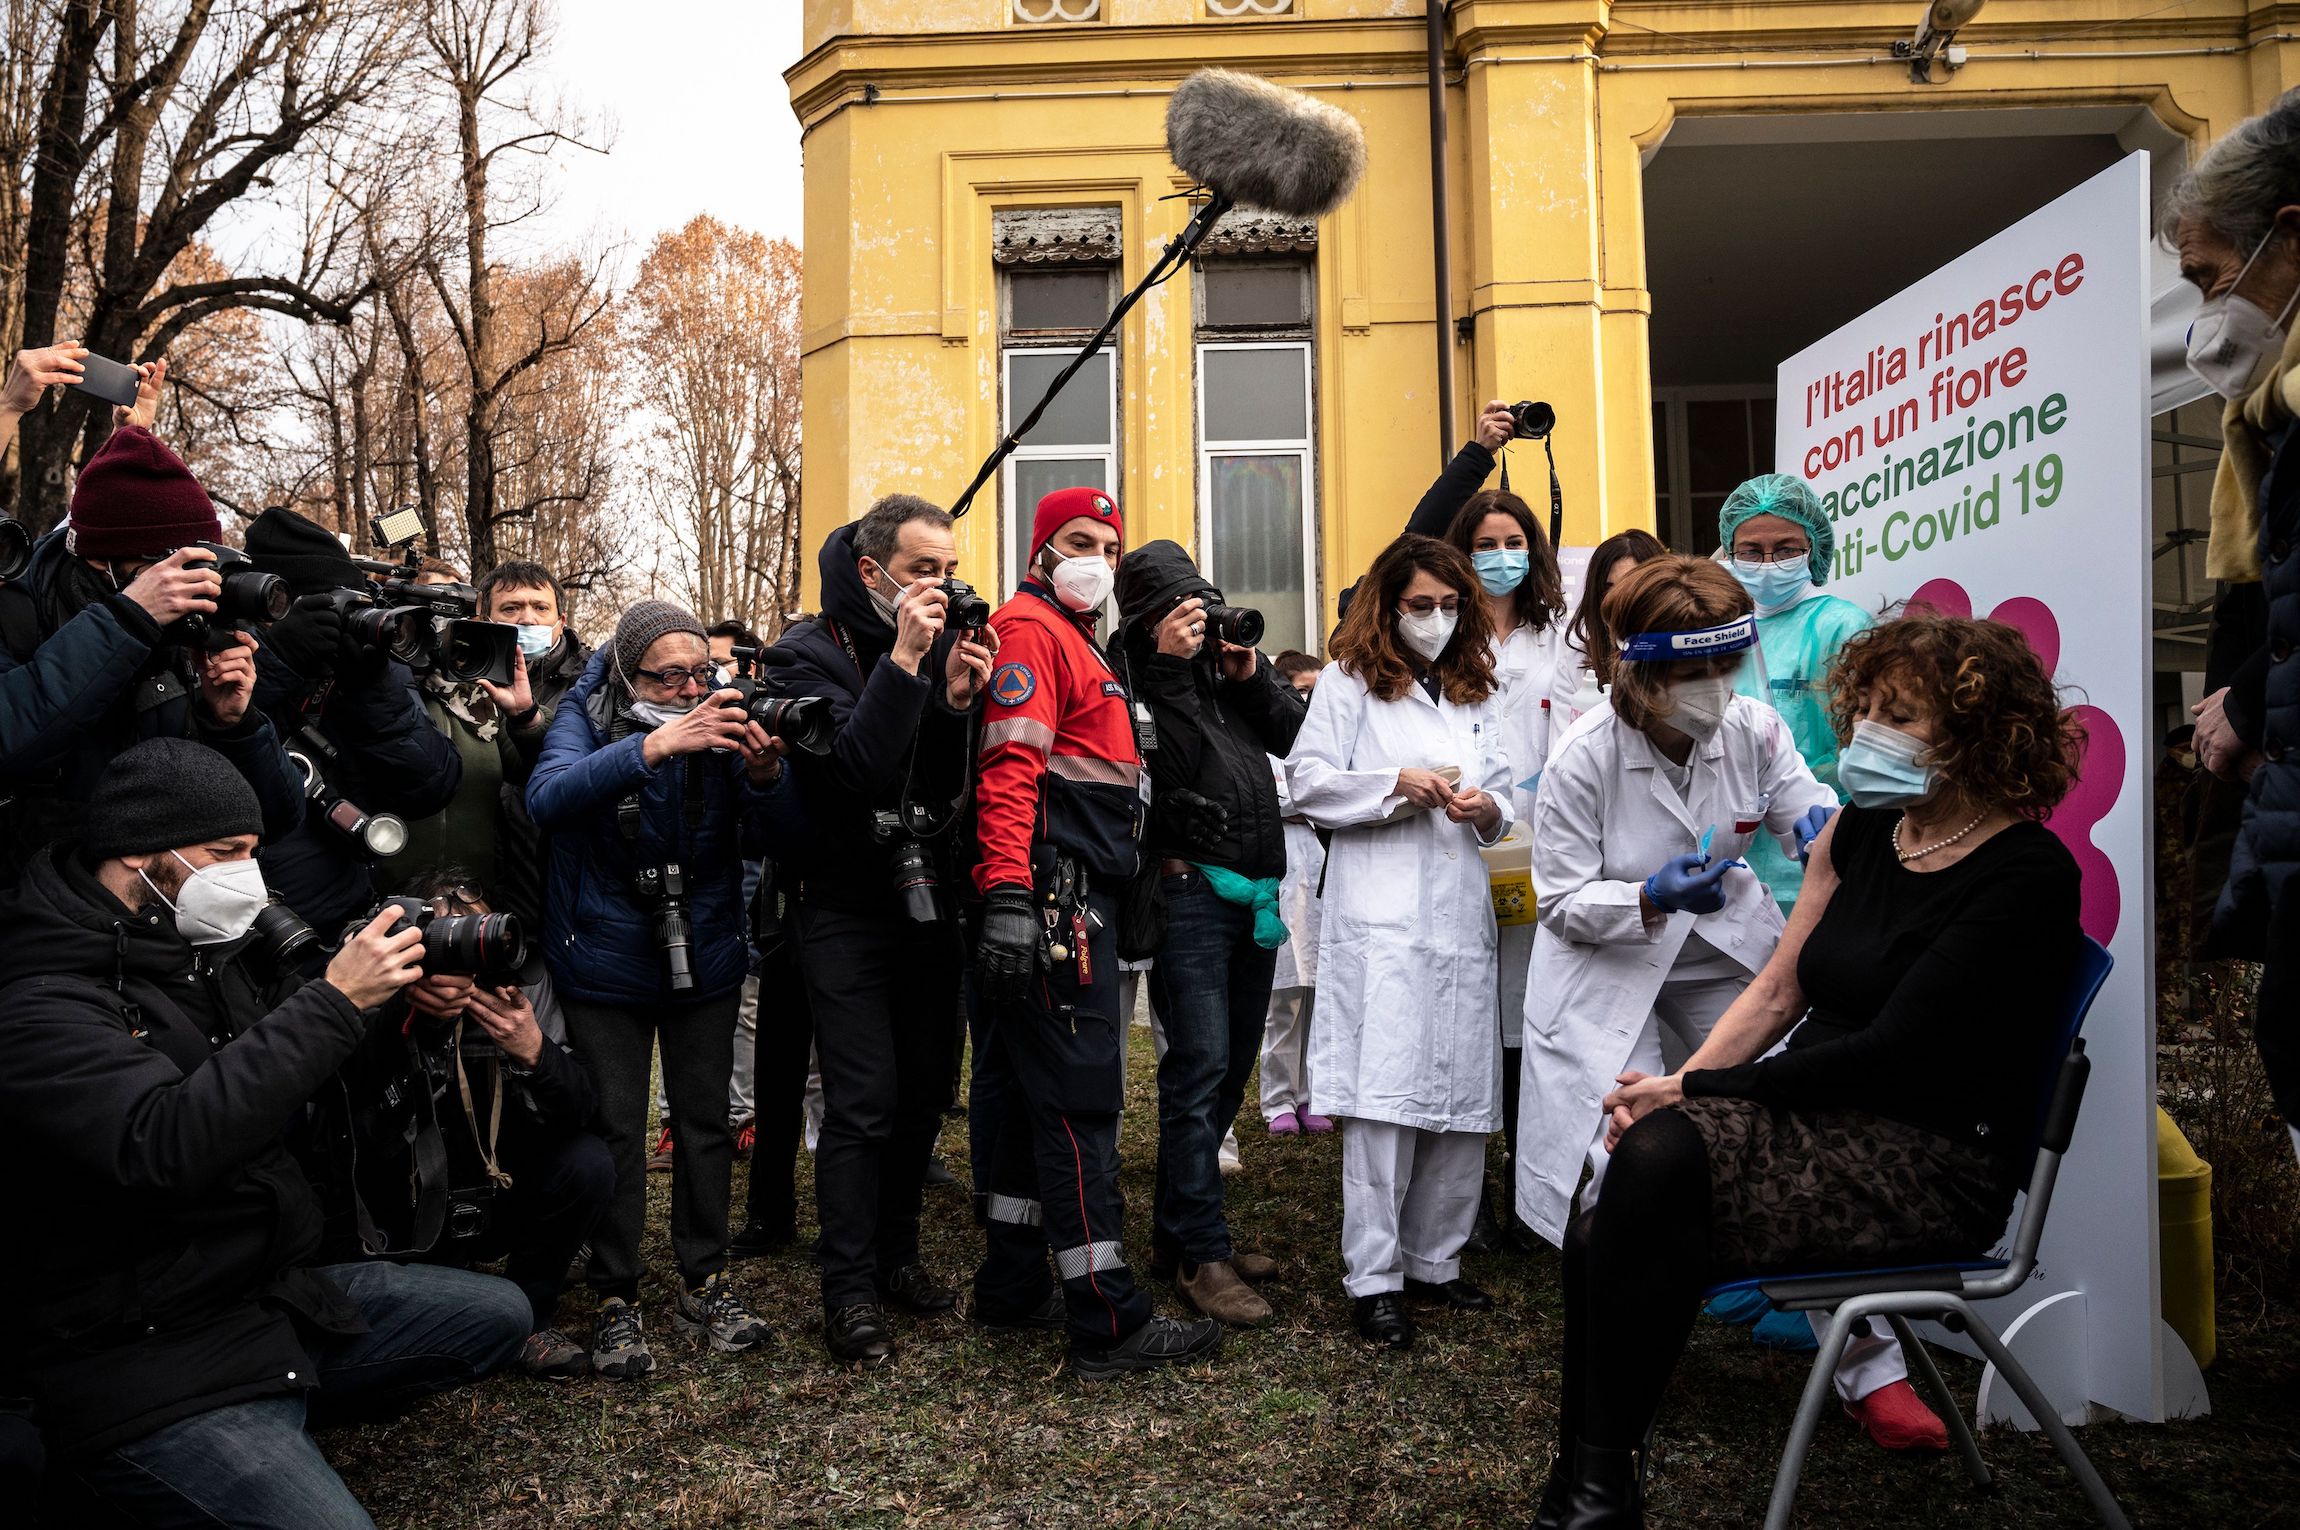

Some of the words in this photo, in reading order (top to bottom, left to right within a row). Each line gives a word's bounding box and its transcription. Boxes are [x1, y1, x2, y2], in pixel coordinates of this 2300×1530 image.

[1918, 252, 2085, 370] rinasce
[1803, 424, 1864, 480] con
[1873, 397, 1919, 448] un
[1928, 346, 2028, 423] fiore
[1818, 392, 2068, 522] accinazione
[1557, 555, 1586, 566] ione
[1831, 473, 2000, 582] nti-Covid
[2011, 453, 2064, 516] 19
[1684, 637, 1712, 646] Face
[1714, 627, 1746, 642] Shield
